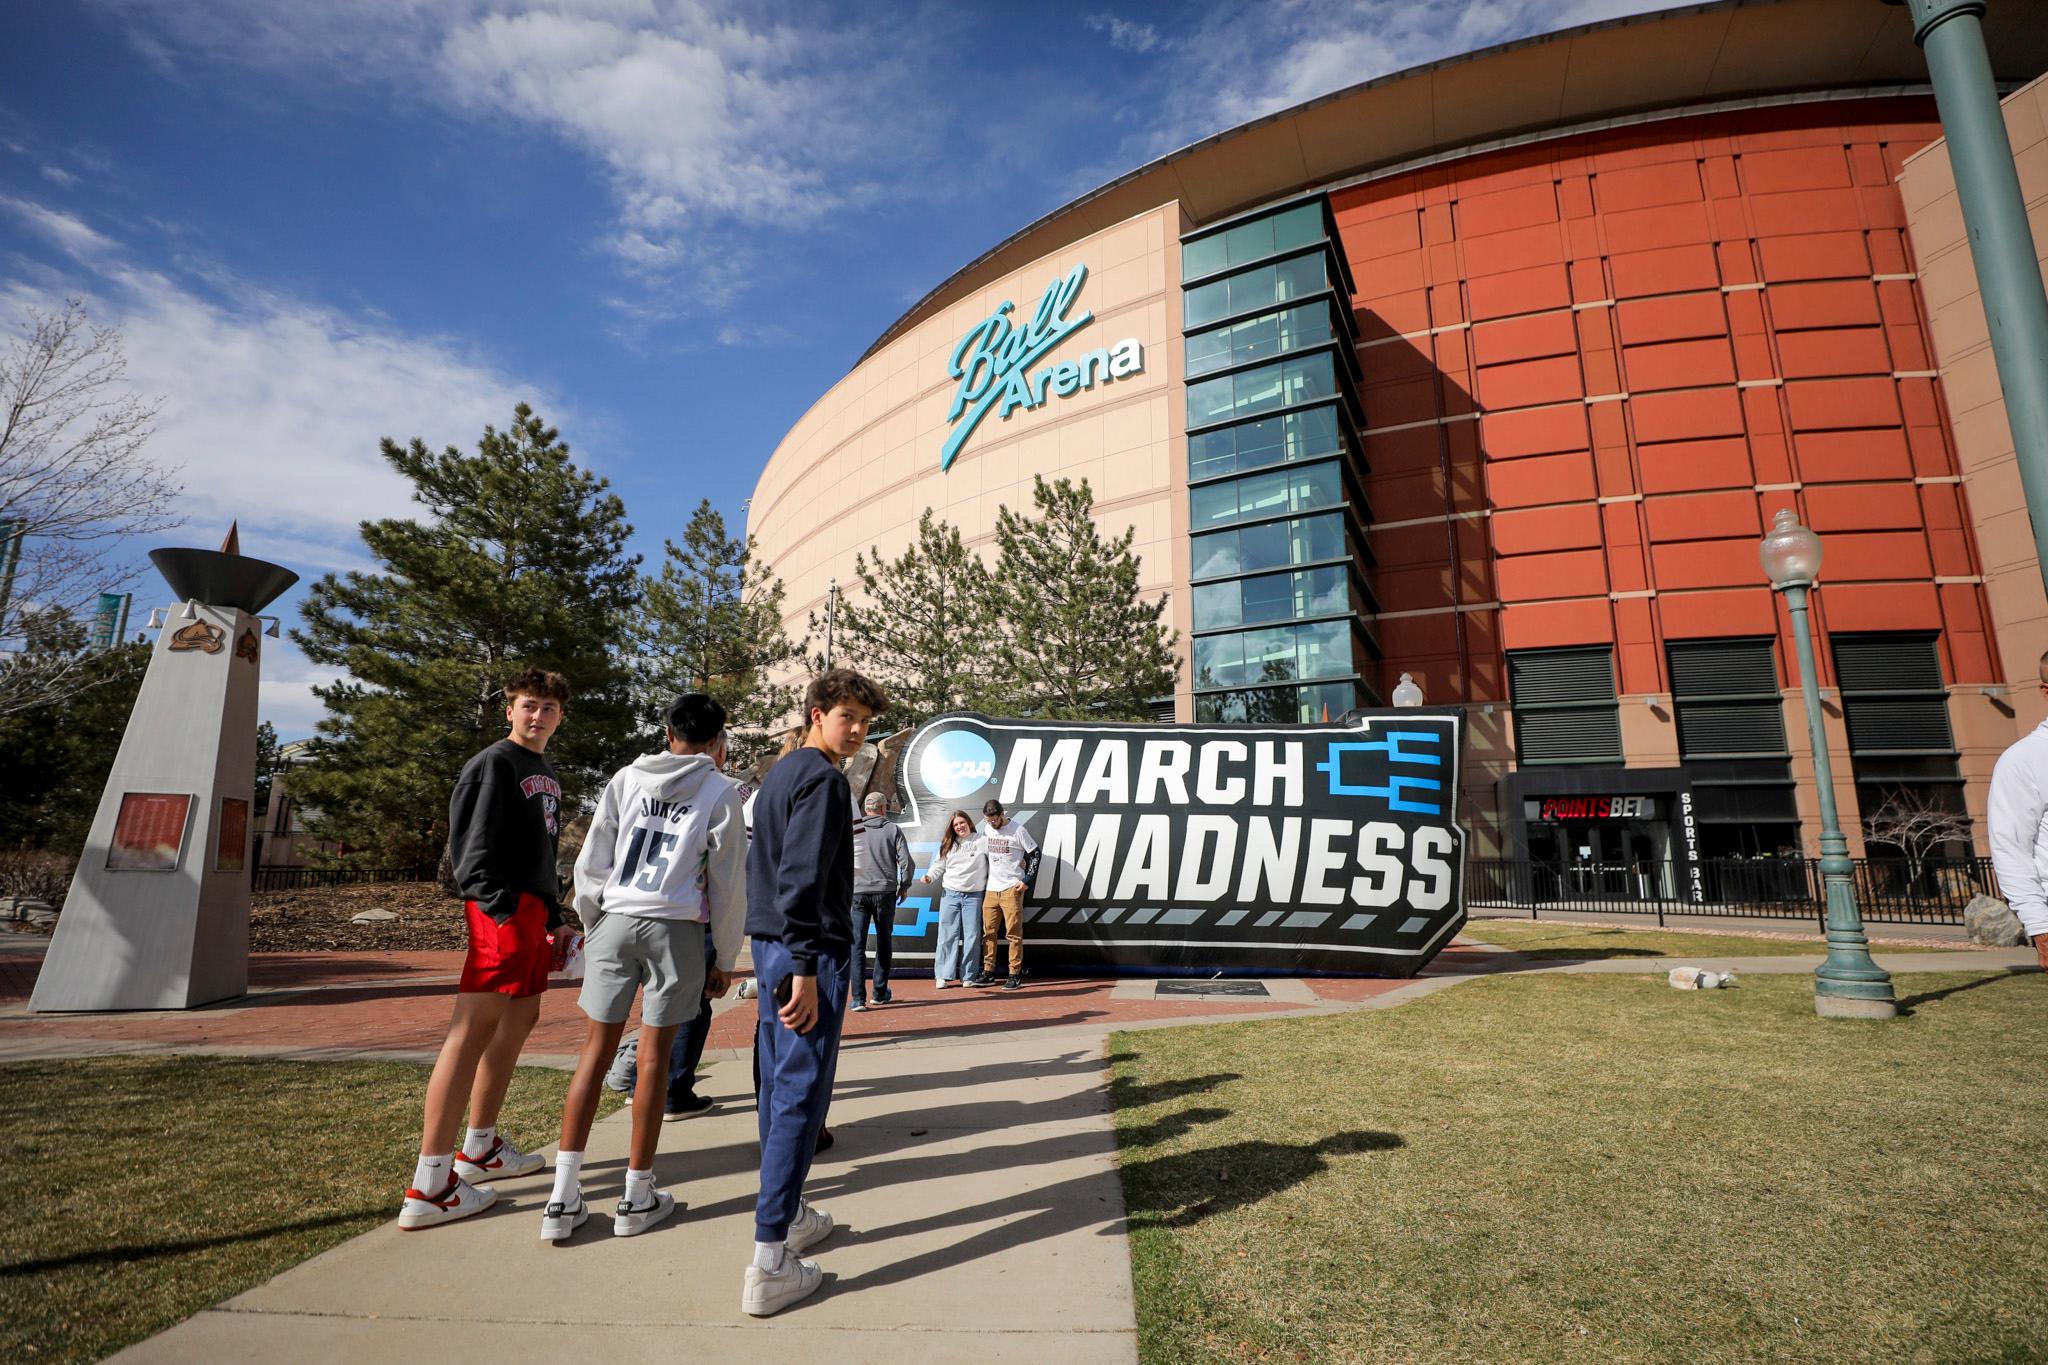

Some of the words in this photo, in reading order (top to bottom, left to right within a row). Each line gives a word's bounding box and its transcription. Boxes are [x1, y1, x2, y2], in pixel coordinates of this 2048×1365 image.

[941, 262, 1093, 471] Ball
[999, 338, 1142, 418] Arena
[923, 760, 992, 781] CAA
[1000, 738, 1303, 806] MARCH
[1543, 797, 1645, 819] POINTSBET
[1681, 793, 1698, 860] SPORTS
[619, 826, 679, 892] 15
[988, 837, 1009, 846] MARCH
[1033, 813, 1453, 911] MADNESS
[1690, 867, 1703, 902] BAR
